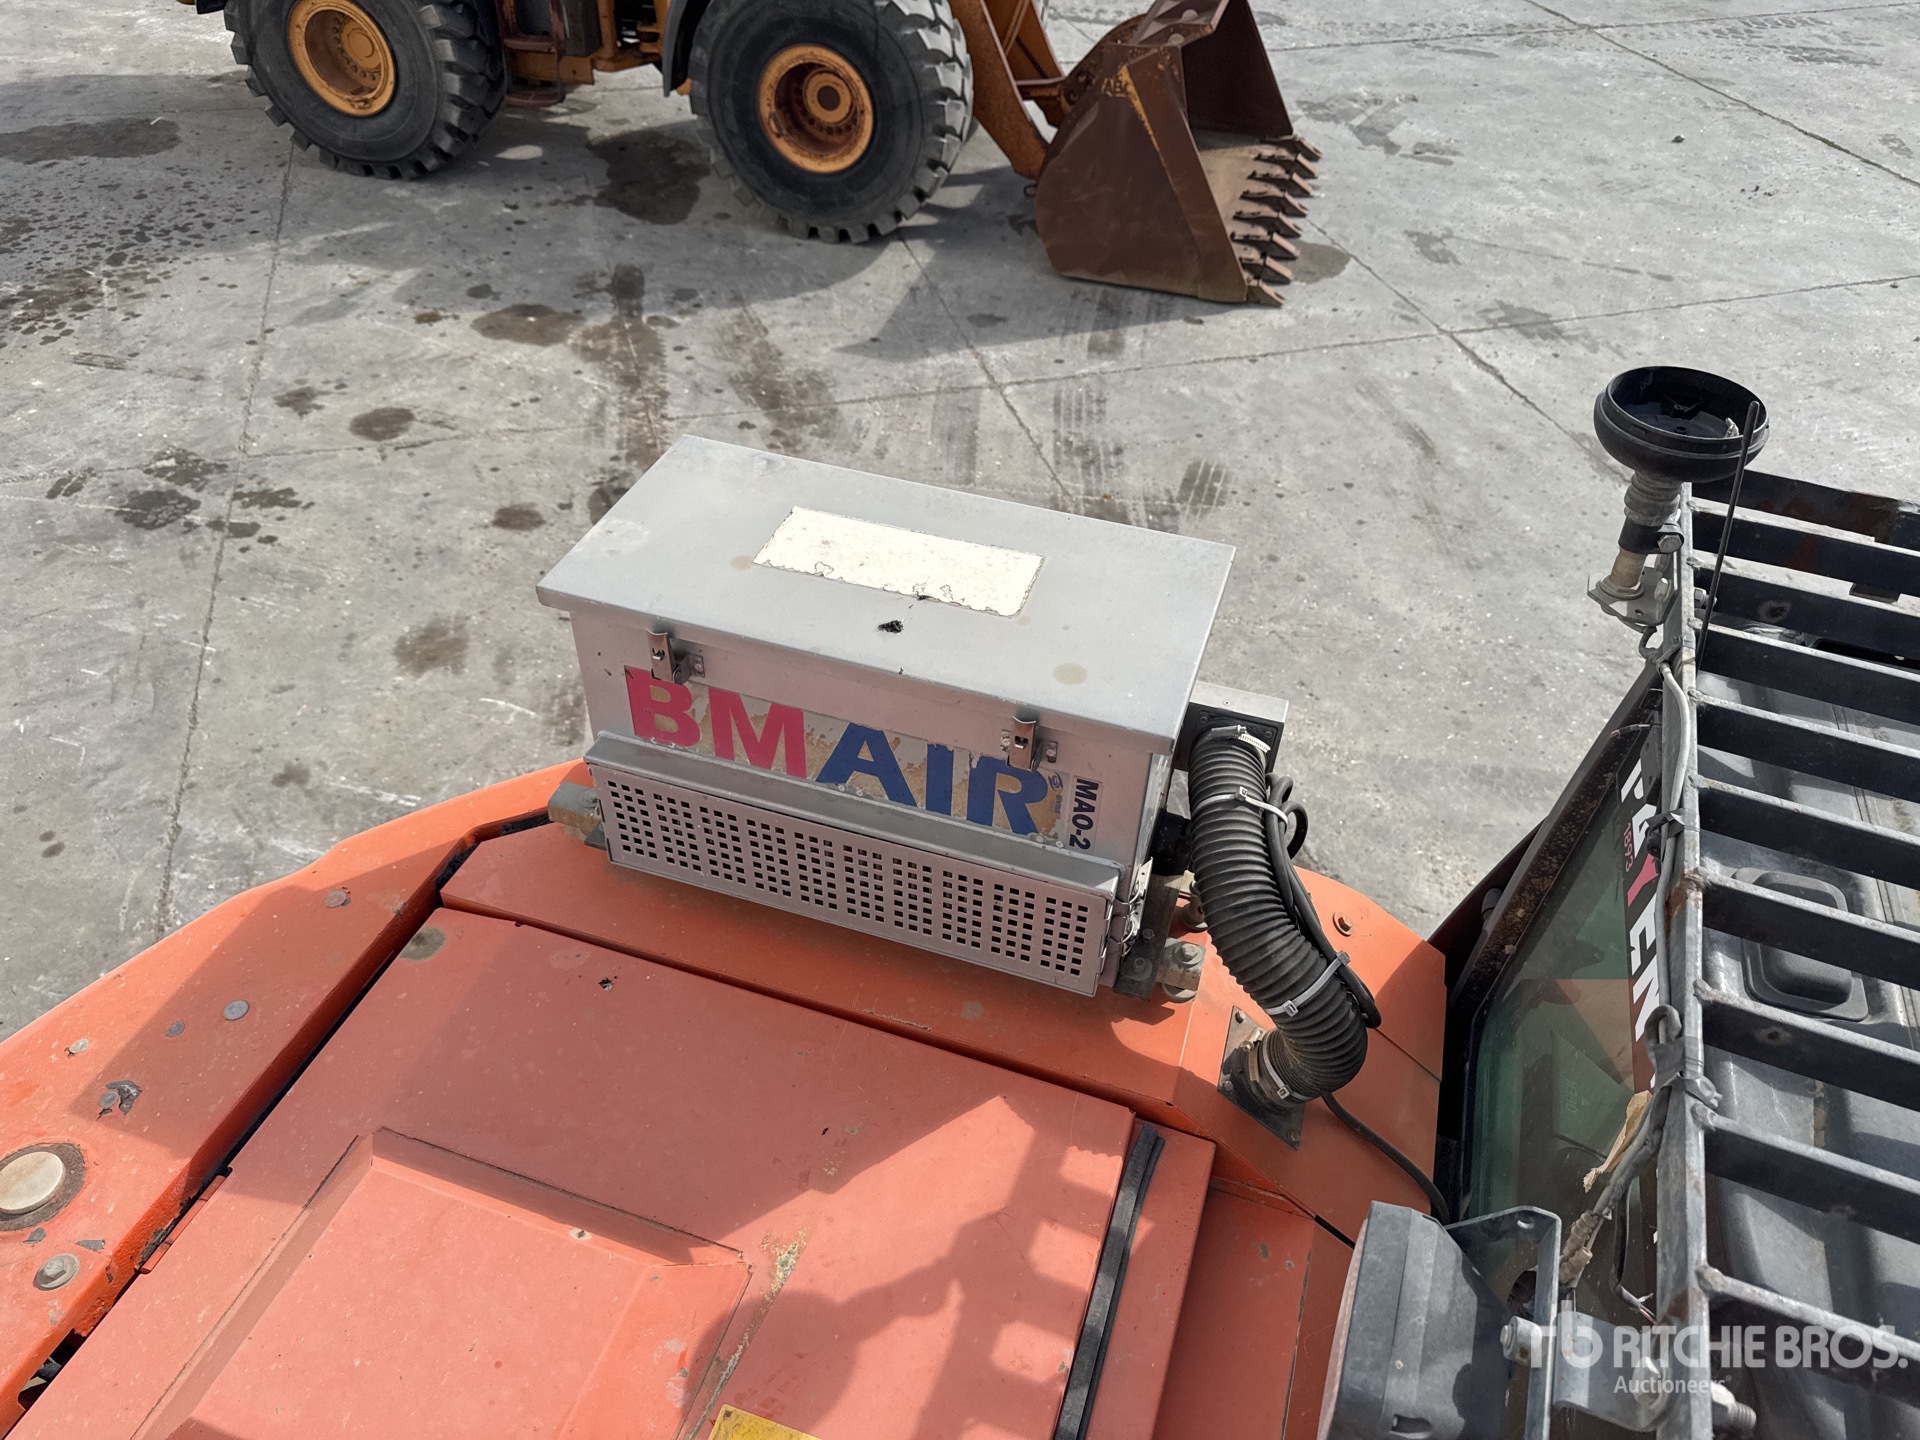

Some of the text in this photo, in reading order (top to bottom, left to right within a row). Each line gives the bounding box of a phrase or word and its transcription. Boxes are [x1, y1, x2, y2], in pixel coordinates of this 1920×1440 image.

[624, 665, 1048, 835] BMAIR
[1069, 778, 1099, 850] MAO-2
[1624, 822, 1634, 873] 1893
